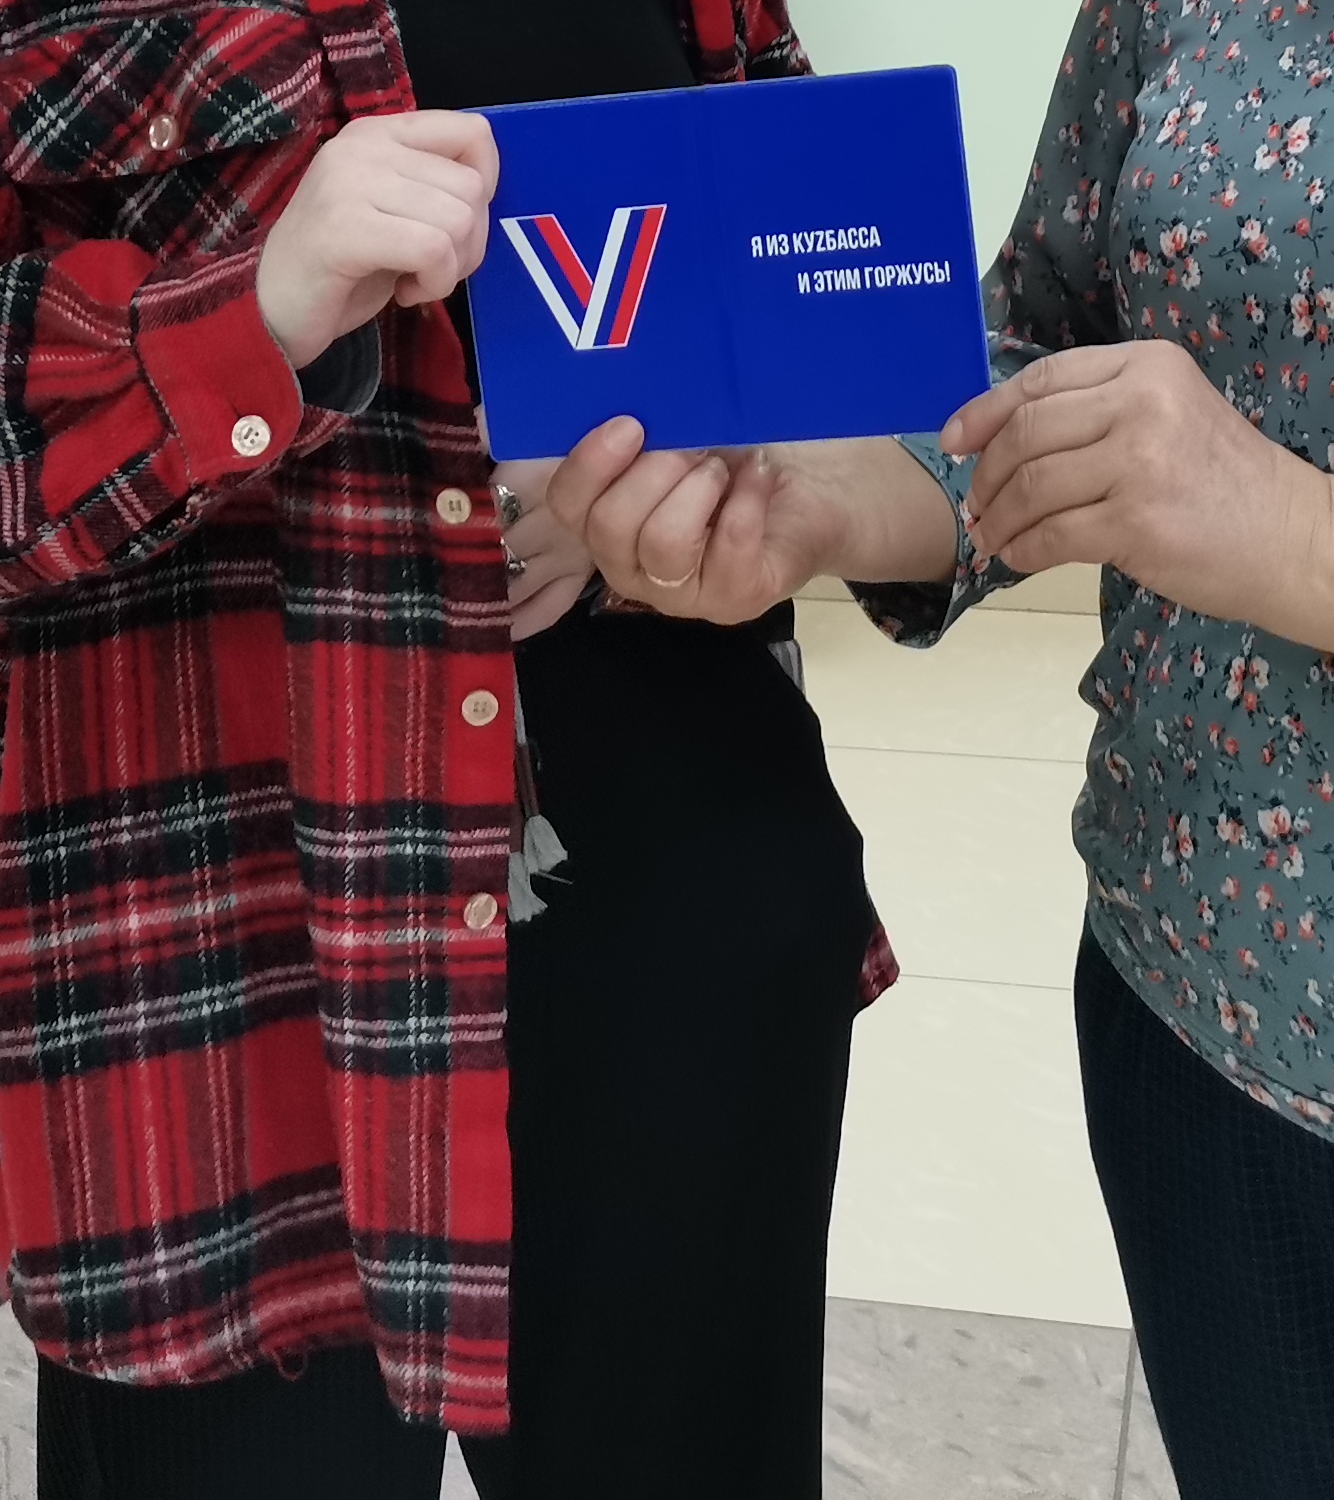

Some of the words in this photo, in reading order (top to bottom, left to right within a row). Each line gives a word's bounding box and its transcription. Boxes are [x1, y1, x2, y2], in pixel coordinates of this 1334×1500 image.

[751, 235, 764, 258] Я
[766, 233, 789, 256] ИЗ
[797, 271, 811, 295] И
[813, 267, 862, 293] ЭТИМ
[864, 260, 951, 289] ГОРЖУСЬ!
